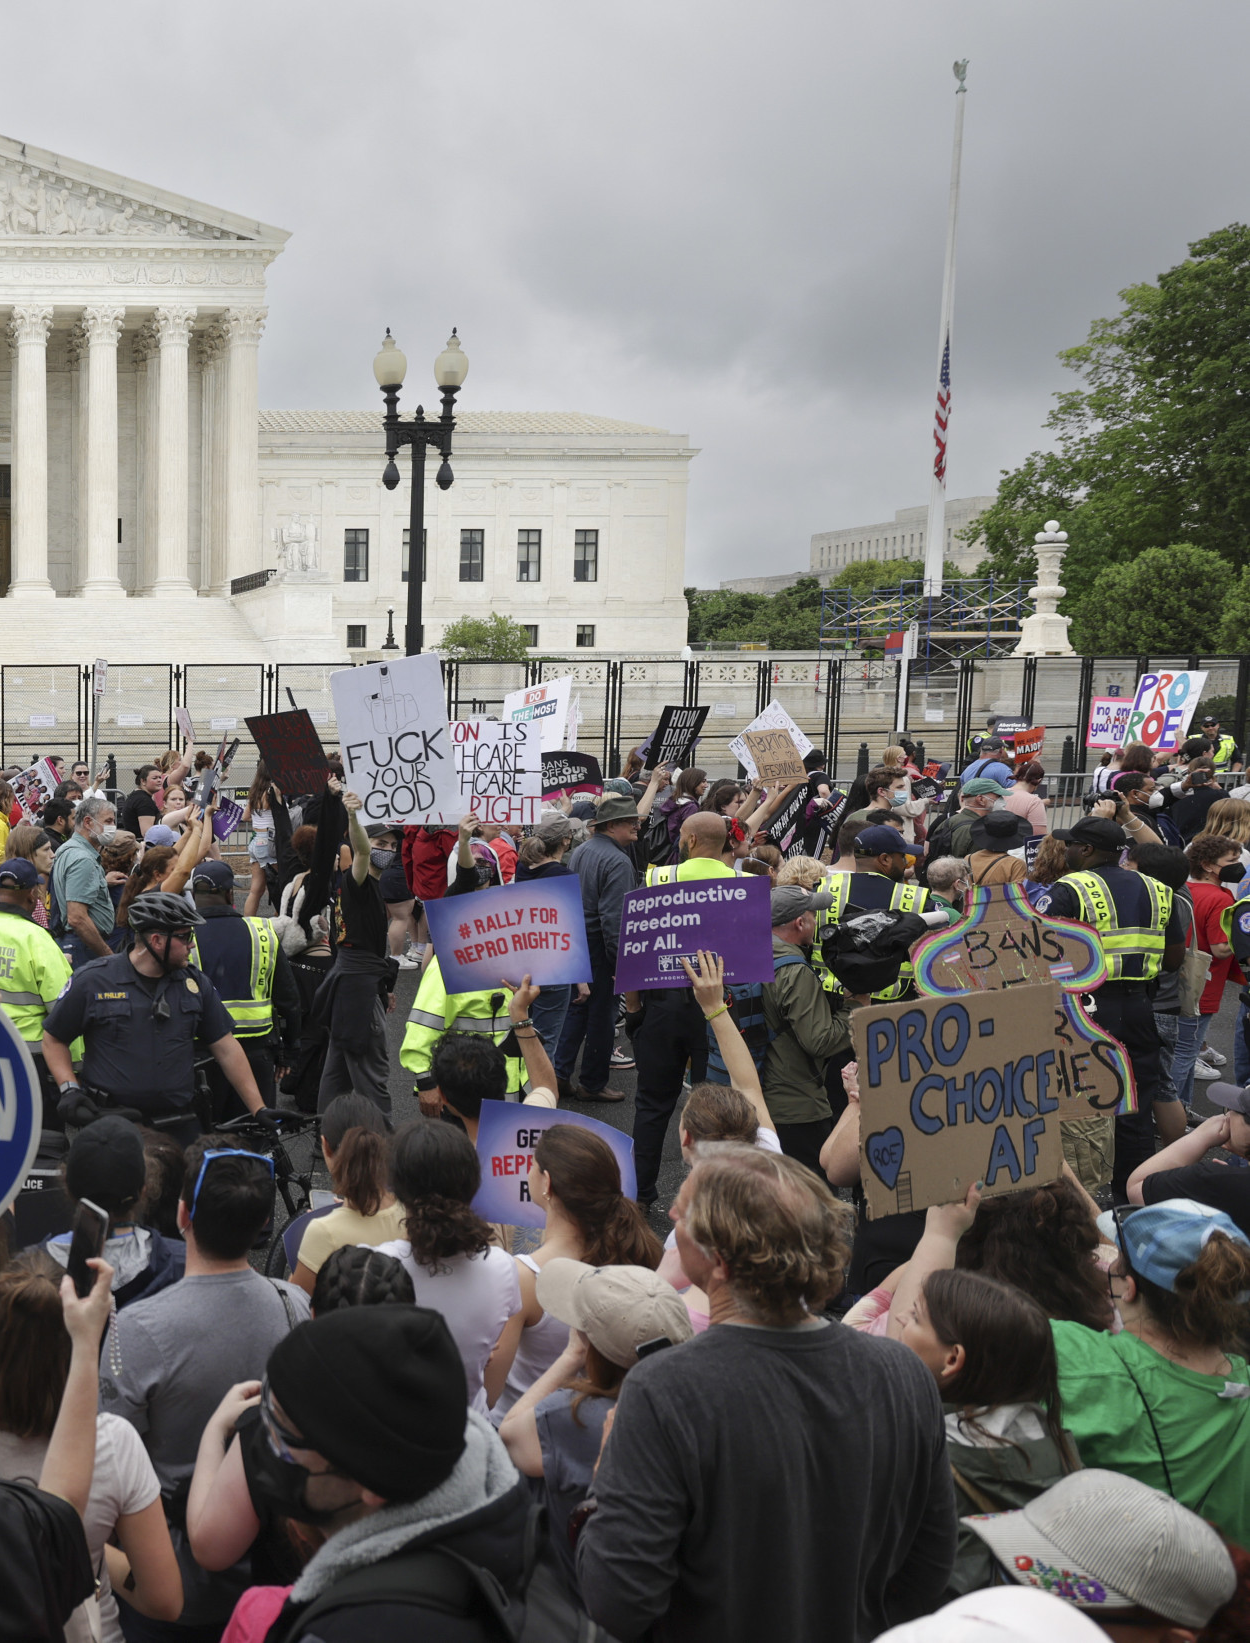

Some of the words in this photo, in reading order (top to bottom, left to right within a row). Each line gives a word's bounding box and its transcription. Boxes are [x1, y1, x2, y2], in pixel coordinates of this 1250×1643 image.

[12, 265, 59, 279] UNDER
[68, 265, 96, 279] LAW
[528, 690, 542, 703] DO
[1133, 672, 1191, 711] PRO
[532, 704, 556, 718] MOST
[669, 709, 700, 728] HOW
[497, 722, 528, 742] IS
[662, 728, 695, 746] DARE
[1123, 709, 1184, 748] ROE
[346, 728, 445, 774] FUCK
[453, 743, 527, 772] THCARE
[366, 761, 431, 790] YOUR
[543, 773, 585, 788] BODIES
[562, 764, 588, 776] OUR
[461, 772, 524, 796] HCARE
[363, 780, 436, 820] GOD
[627, 885, 748, 914] Reproductive
[1084, 880, 1108, 921] USCP
[529, 907, 558, 925] FOR
[625, 912, 701, 935] Freedom
[257, 926, 268, 987] POLICE
[453, 937, 509, 966] REPRO
[511, 931, 571, 951] RIGHTS
[623, 940, 649, 957] For
[653, 933, 683, 951] All.
[963, 919, 1065, 970] BANS
[675, 955, 699, 965] NAR
[910, 1049, 1060, 1136] CHOICE
[872, 1142, 901, 1167] ROE
[985, 1117, 1046, 1187] AF
[21, 1179, 44, 1190] LICE
